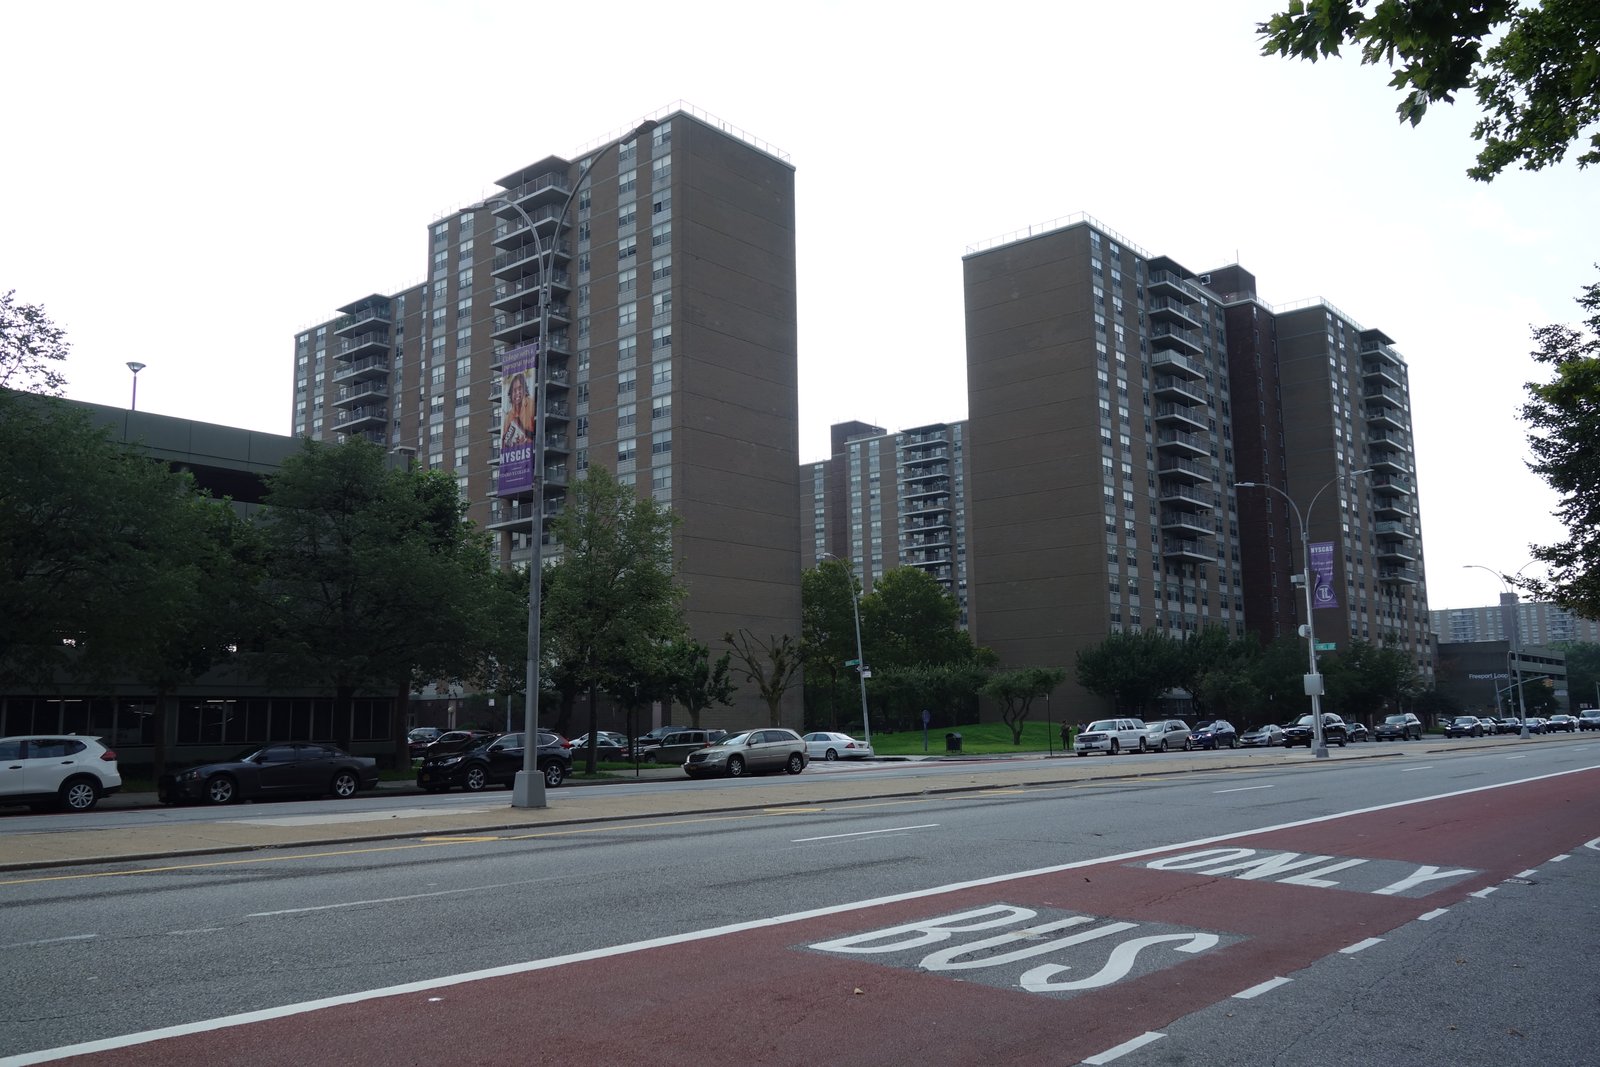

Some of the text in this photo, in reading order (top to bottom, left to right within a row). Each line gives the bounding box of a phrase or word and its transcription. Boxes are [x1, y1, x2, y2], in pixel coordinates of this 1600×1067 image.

[500, 448, 531, 464] NYSCAS
[1310, 545, 1333, 553] NYSCAS
[1145, 848, 1476, 896] ONLY
[807, 904, 1220, 993] BUS
